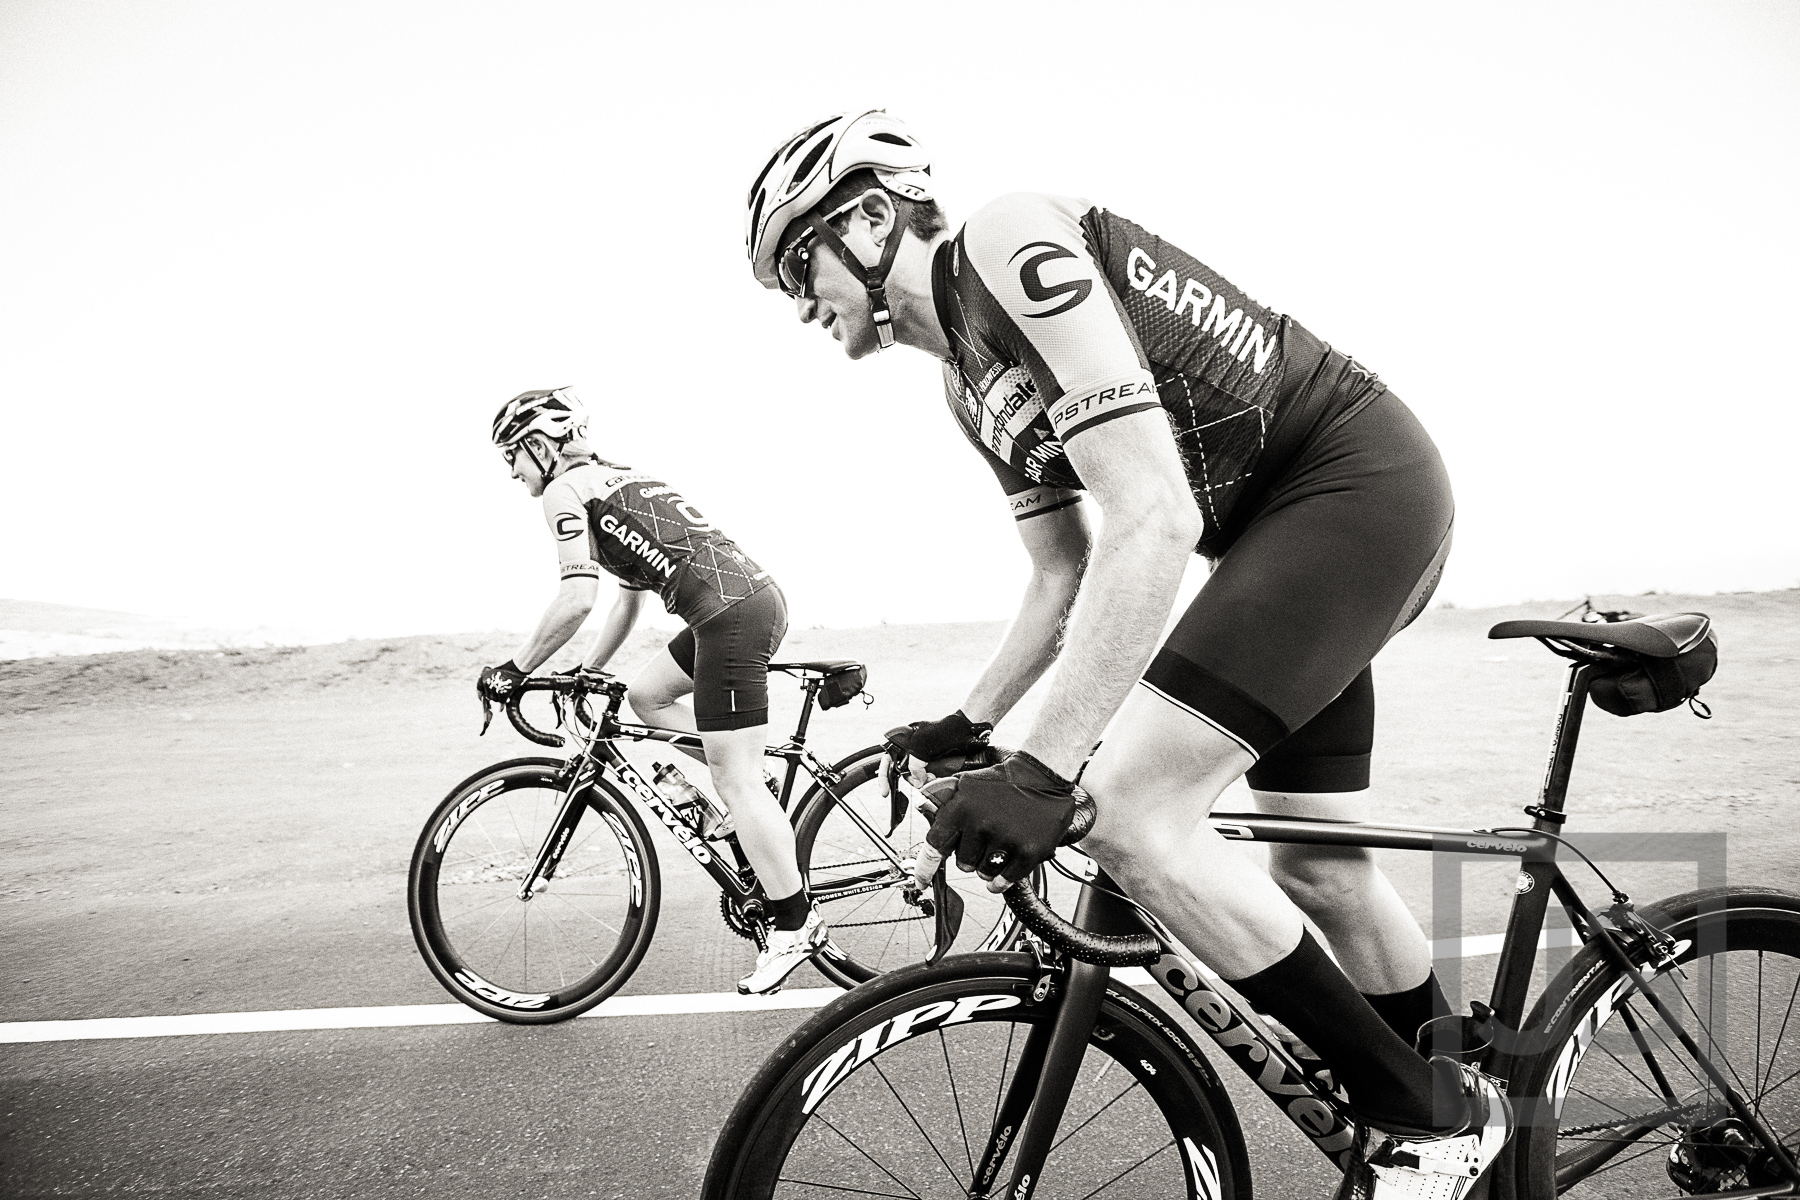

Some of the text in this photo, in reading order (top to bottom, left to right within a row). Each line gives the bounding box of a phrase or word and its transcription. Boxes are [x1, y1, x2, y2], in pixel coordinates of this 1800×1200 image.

[1126, 246, 1277, 374] GARMIN
[600, 514, 677, 578] GARMIN
[434, 779, 505, 853] ZIPP
[602, 811, 643, 908] ZIPP
[455, 968, 551, 1009] ZIPP
[1550, 959, 1607, 1029] CONTINENTAL
[802, 994, 1022, 1115] ZIPP
